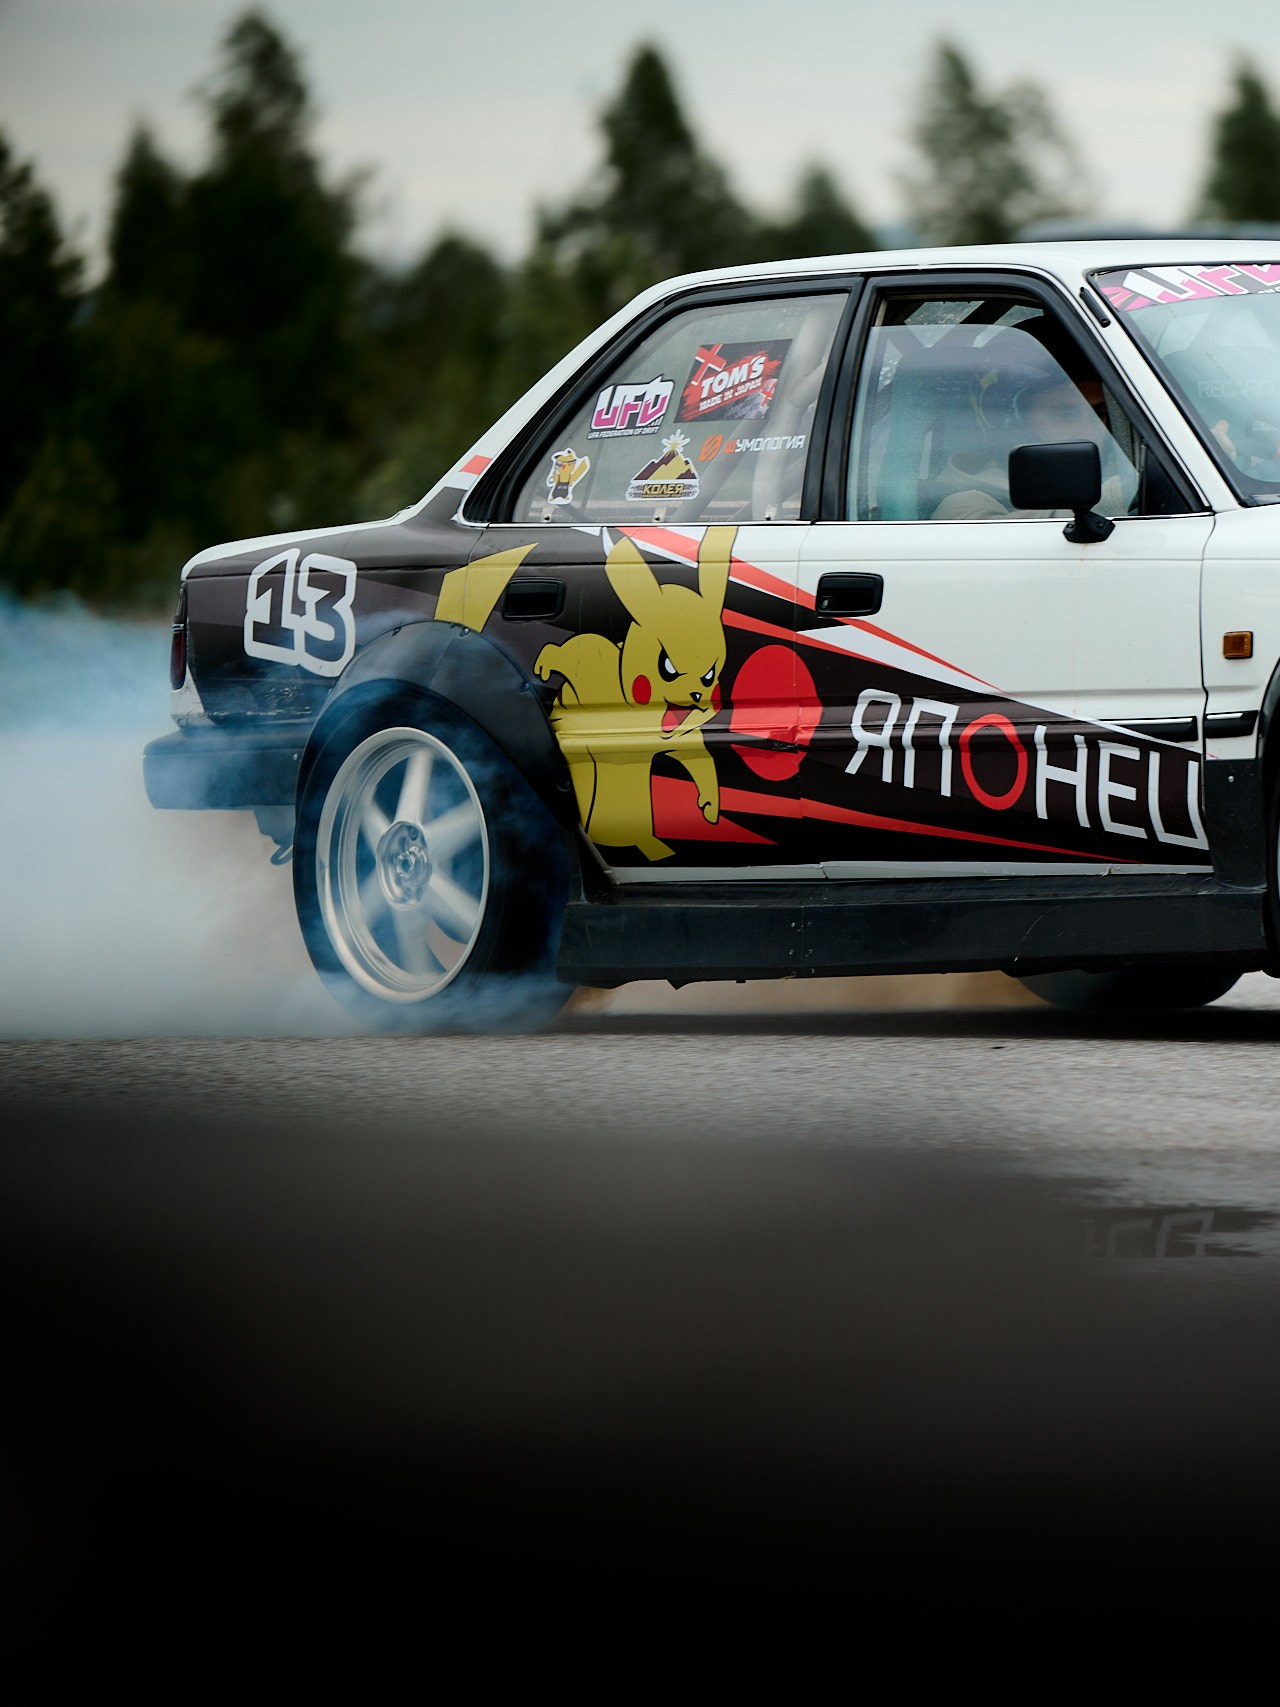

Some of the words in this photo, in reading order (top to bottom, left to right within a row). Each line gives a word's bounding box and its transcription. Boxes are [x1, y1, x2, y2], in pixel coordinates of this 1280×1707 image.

[591, 376, 675, 429] UFD
[724, 435, 806, 453] ШУМОЛОГИЯ
[643, 484, 685, 495] КОЛЕЯ
[244, 548, 358, 677] 13
